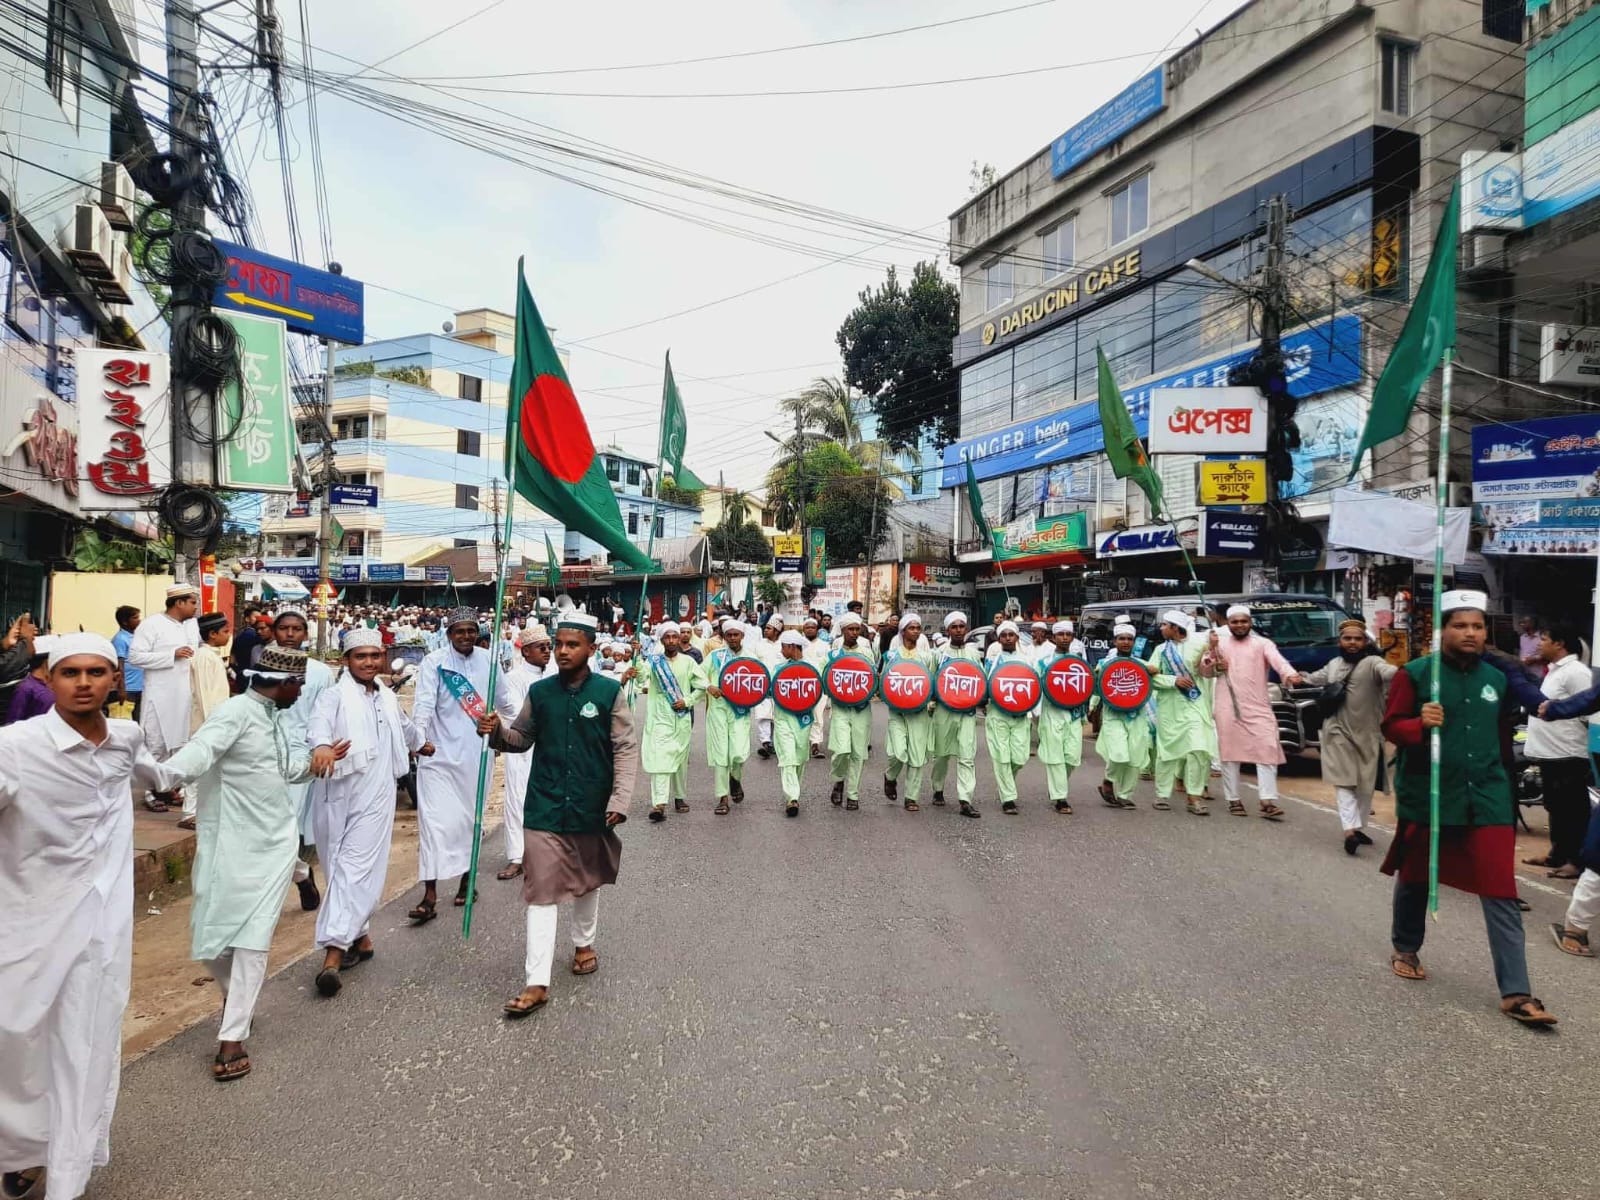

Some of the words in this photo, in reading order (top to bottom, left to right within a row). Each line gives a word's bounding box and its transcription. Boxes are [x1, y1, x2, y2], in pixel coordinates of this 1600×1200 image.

[1000, 278, 1079, 336] DARUCINI
[1084, 250, 1141, 295] CAFE
[1168, 405, 1253, 435] এপেক্স
[959, 430, 1025, 462] SINGER
[1035, 419, 1070, 444] beko
[1211, 469, 1256, 482] দারুচিনি
[1117, 528, 1178, 551] WALKA
[925, 565, 961, 577] BERGER
[724, 665, 766, 694] পবিত্র
[777, 677, 818, 699] জশনে
[832, 668, 871, 695] জুলুছে
[888, 669, 925, 697] ঈদে
[944, 666, 981, 697] মিলা
[997, 677, 1035, 704] দুন
[1051, 663, 1090, 694] নবী
